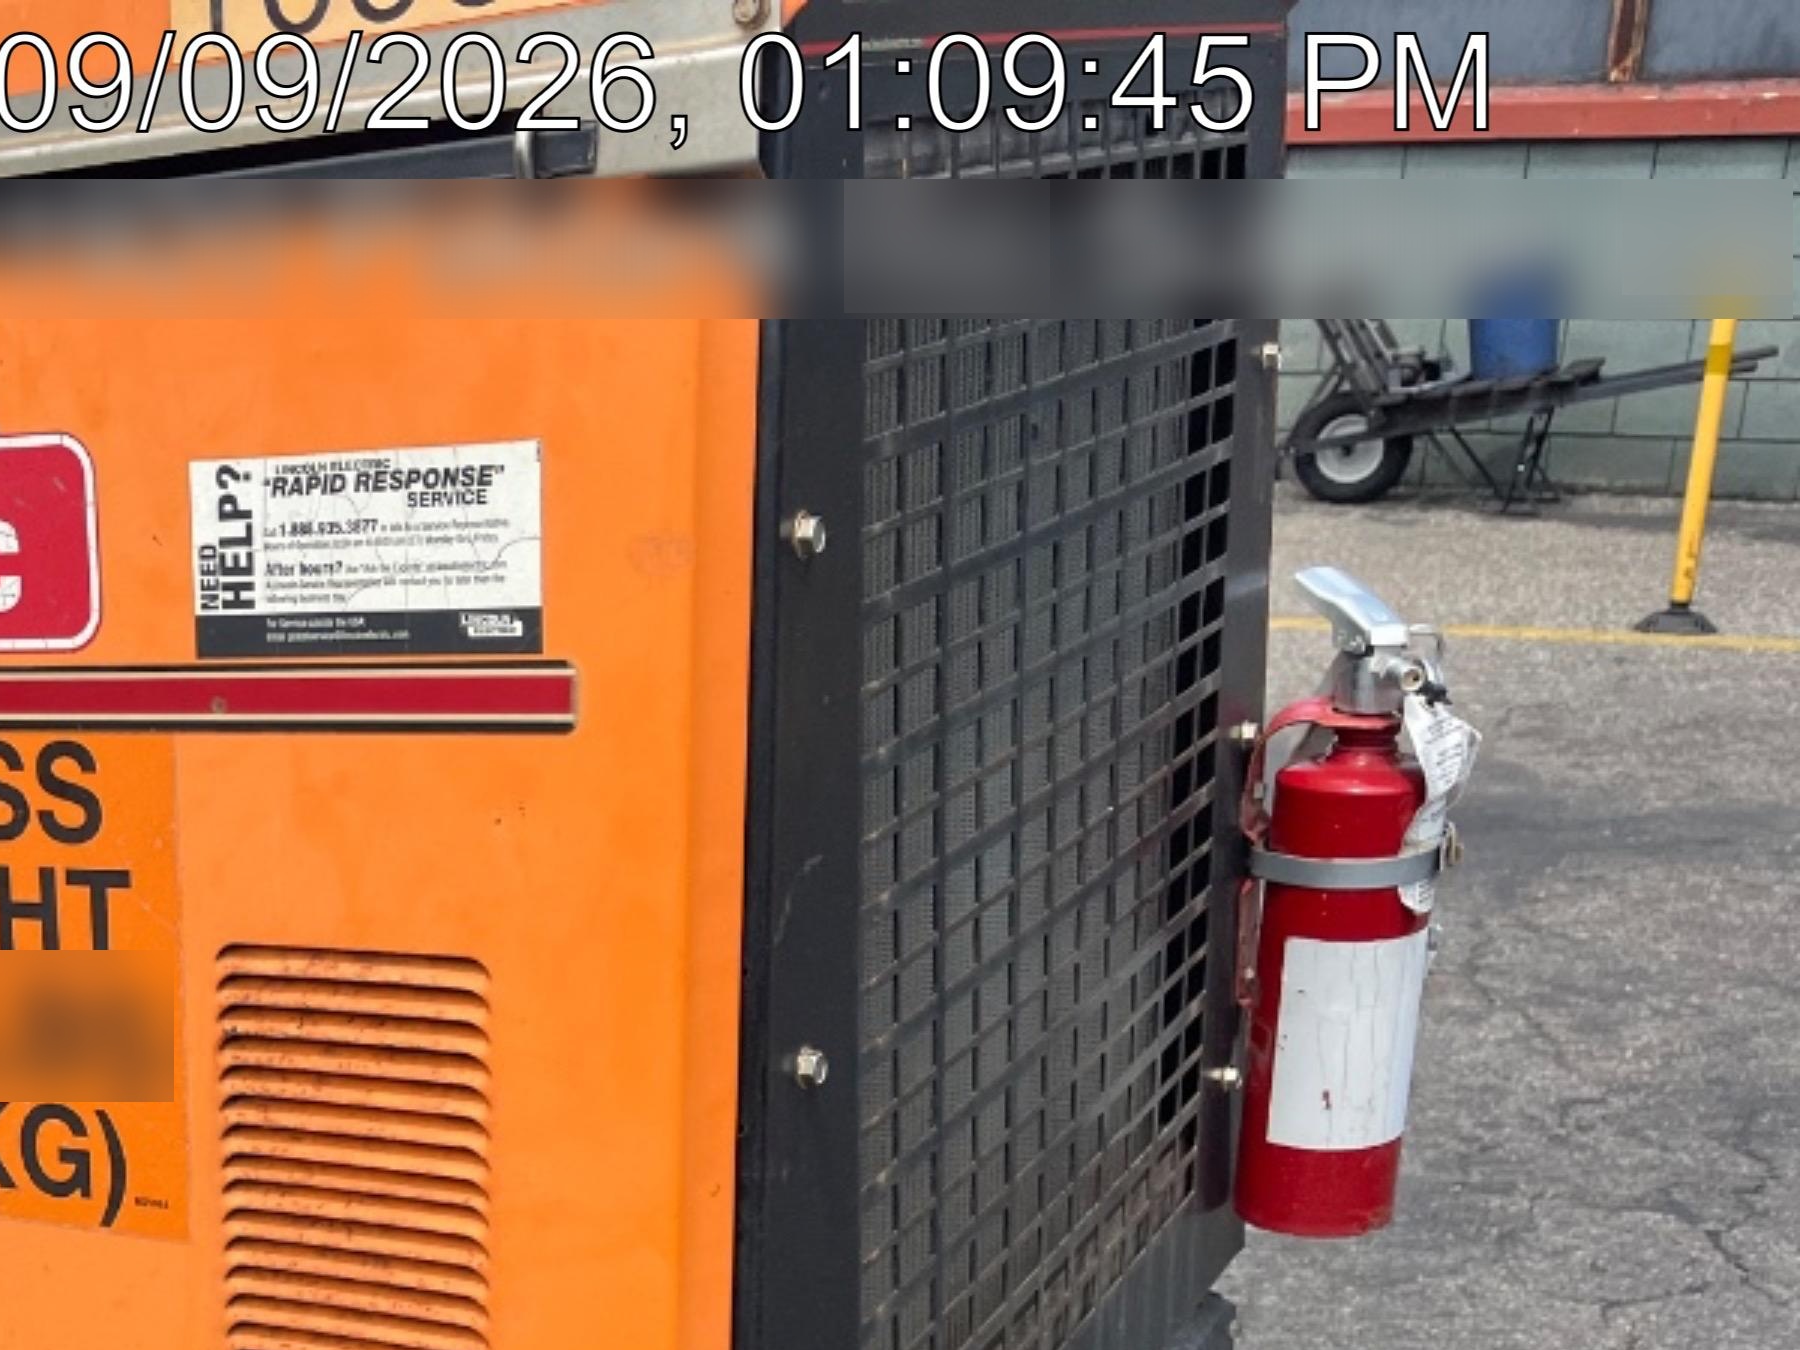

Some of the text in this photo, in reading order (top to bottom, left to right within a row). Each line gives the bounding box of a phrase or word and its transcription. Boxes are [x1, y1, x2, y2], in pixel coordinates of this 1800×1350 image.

[407, 489, 488, 508] SERVICE
[216, 464, 256, 609] HELP?
[199, 545, 220, 610] NEED
